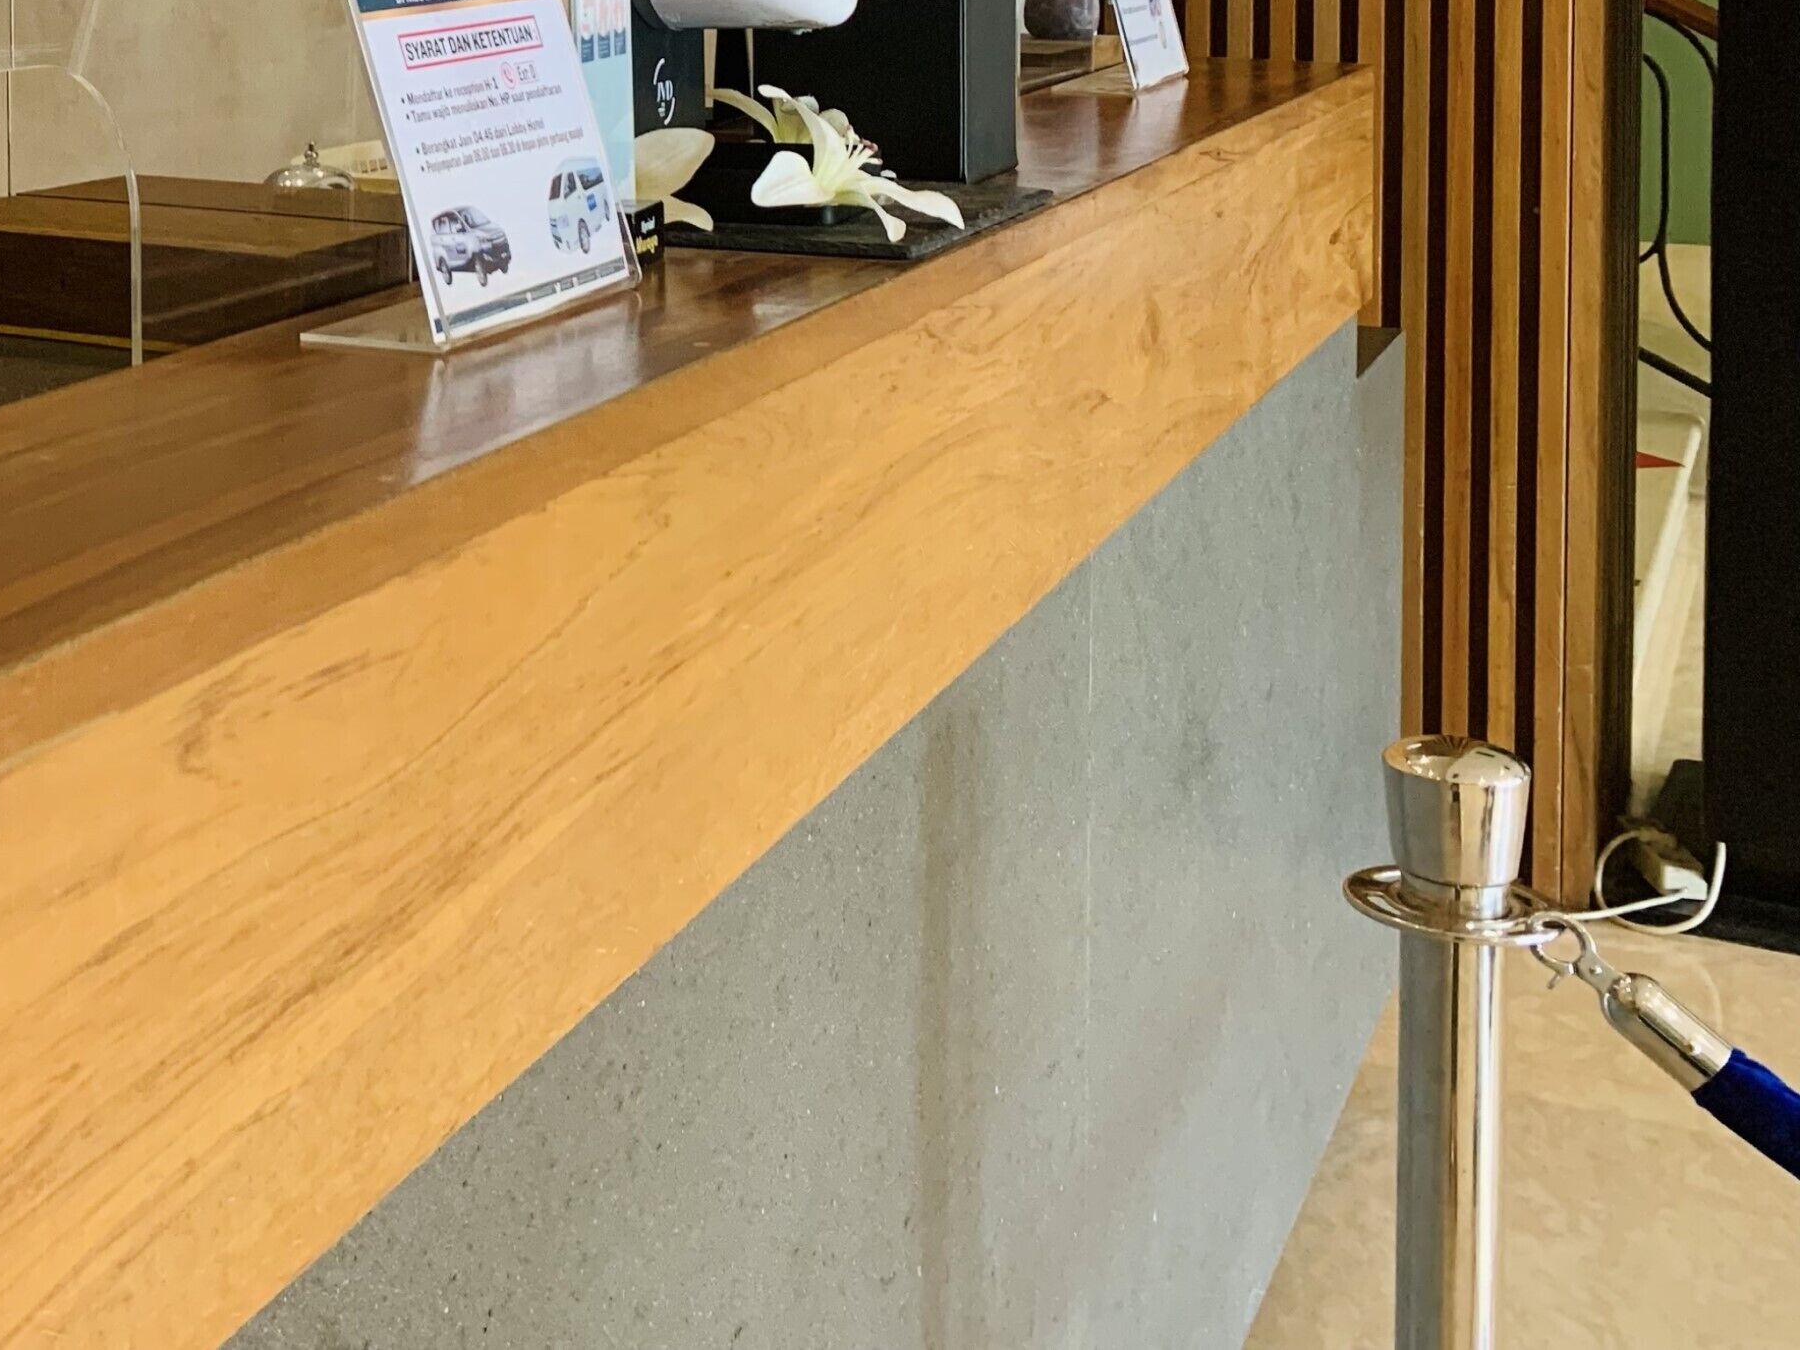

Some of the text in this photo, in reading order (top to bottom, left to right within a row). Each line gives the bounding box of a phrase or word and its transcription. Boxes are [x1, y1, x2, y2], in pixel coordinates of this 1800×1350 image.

[404, 24, 534, 62] SYARAT DAN KETENTUAN
[271, 687, 315, 714] Kyriad
